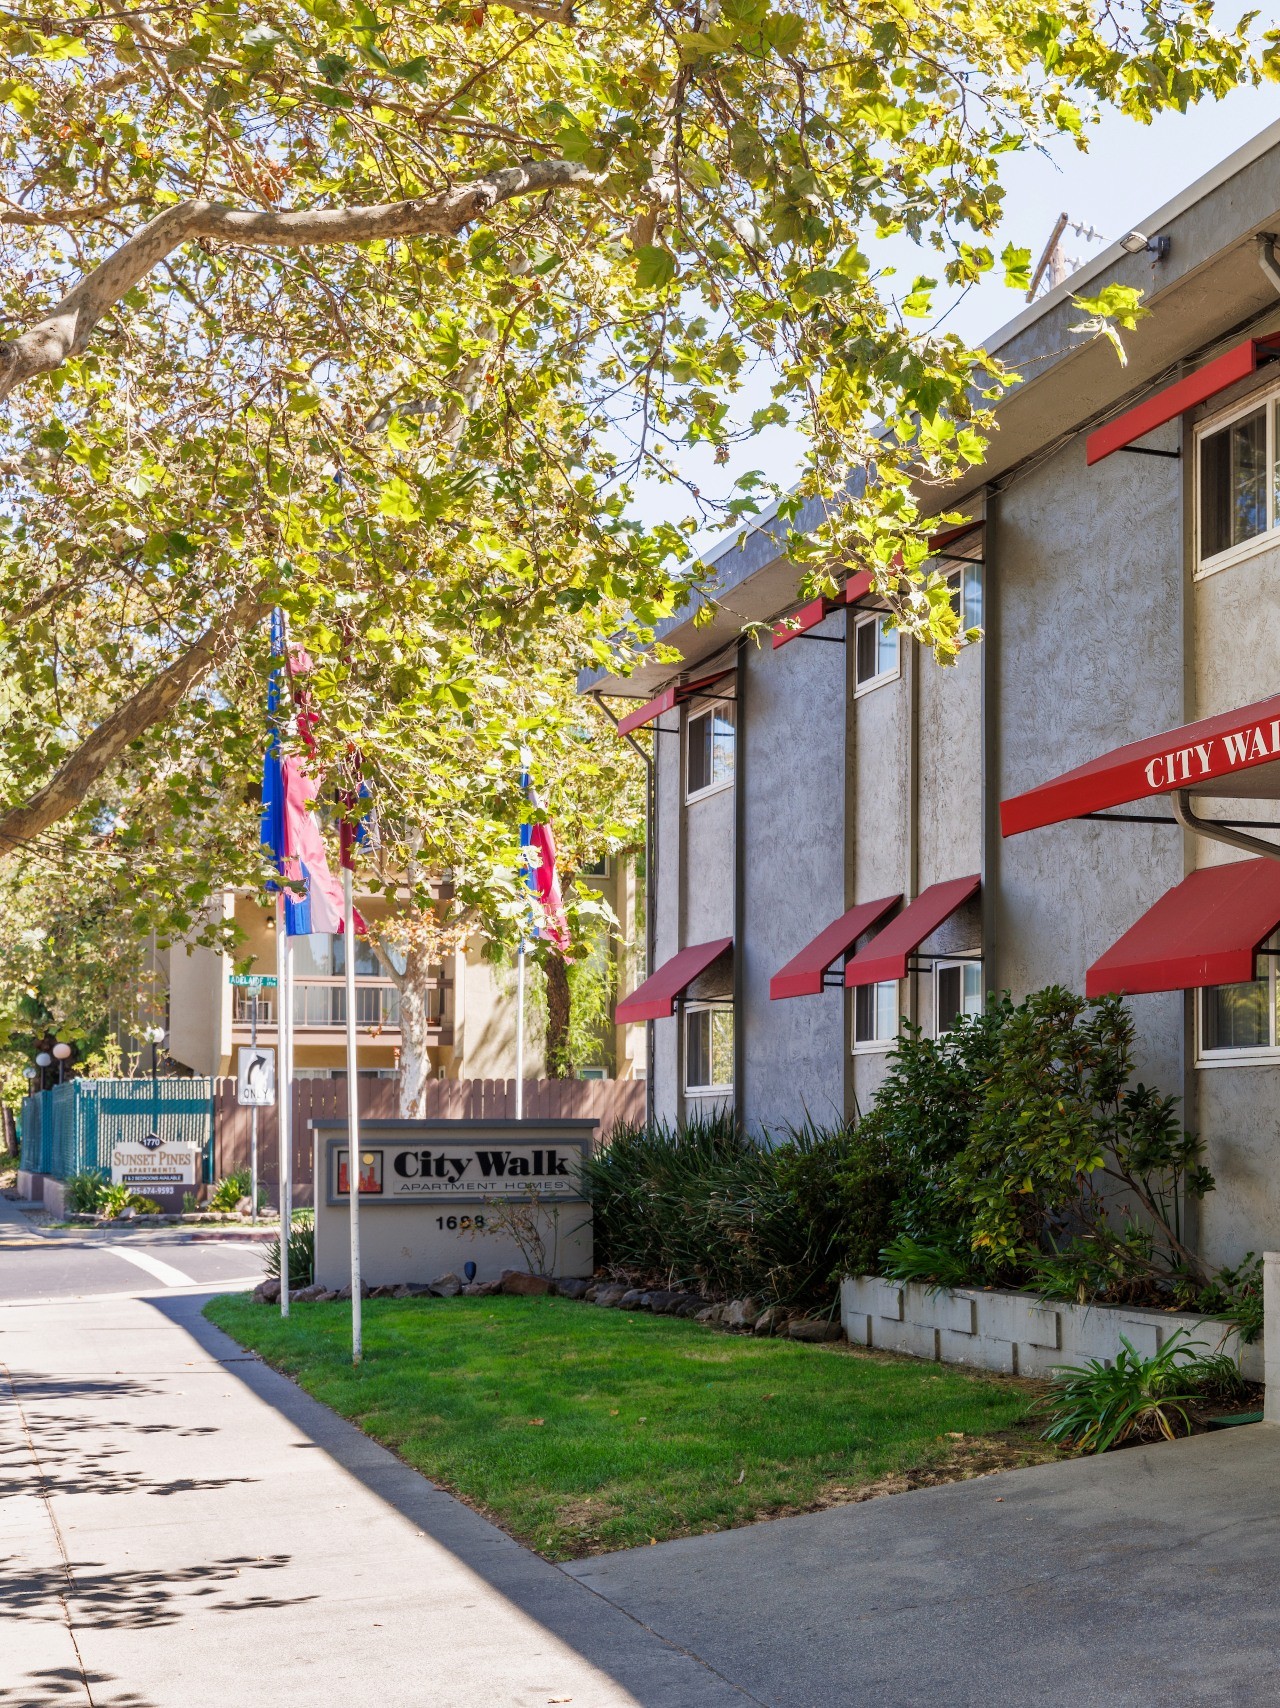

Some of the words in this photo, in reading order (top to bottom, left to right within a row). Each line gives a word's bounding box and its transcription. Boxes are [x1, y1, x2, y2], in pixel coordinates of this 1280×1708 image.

[1144, 740, 1214, 788] CITY
[231, 976, 263, 985] ADELAIDE
[143, 1138, 160, 1146] 1770
[114, 1152, 157, 1166] SUNSET
[159, 1152, 191, 1166] PINES
[393, 1150, 472, 1183] City
[475, 1150, 570, 1177] Walk
[400, 1182, 497, 1191] APARTMENT
[504, 1181, 564, 1189] HOMES
